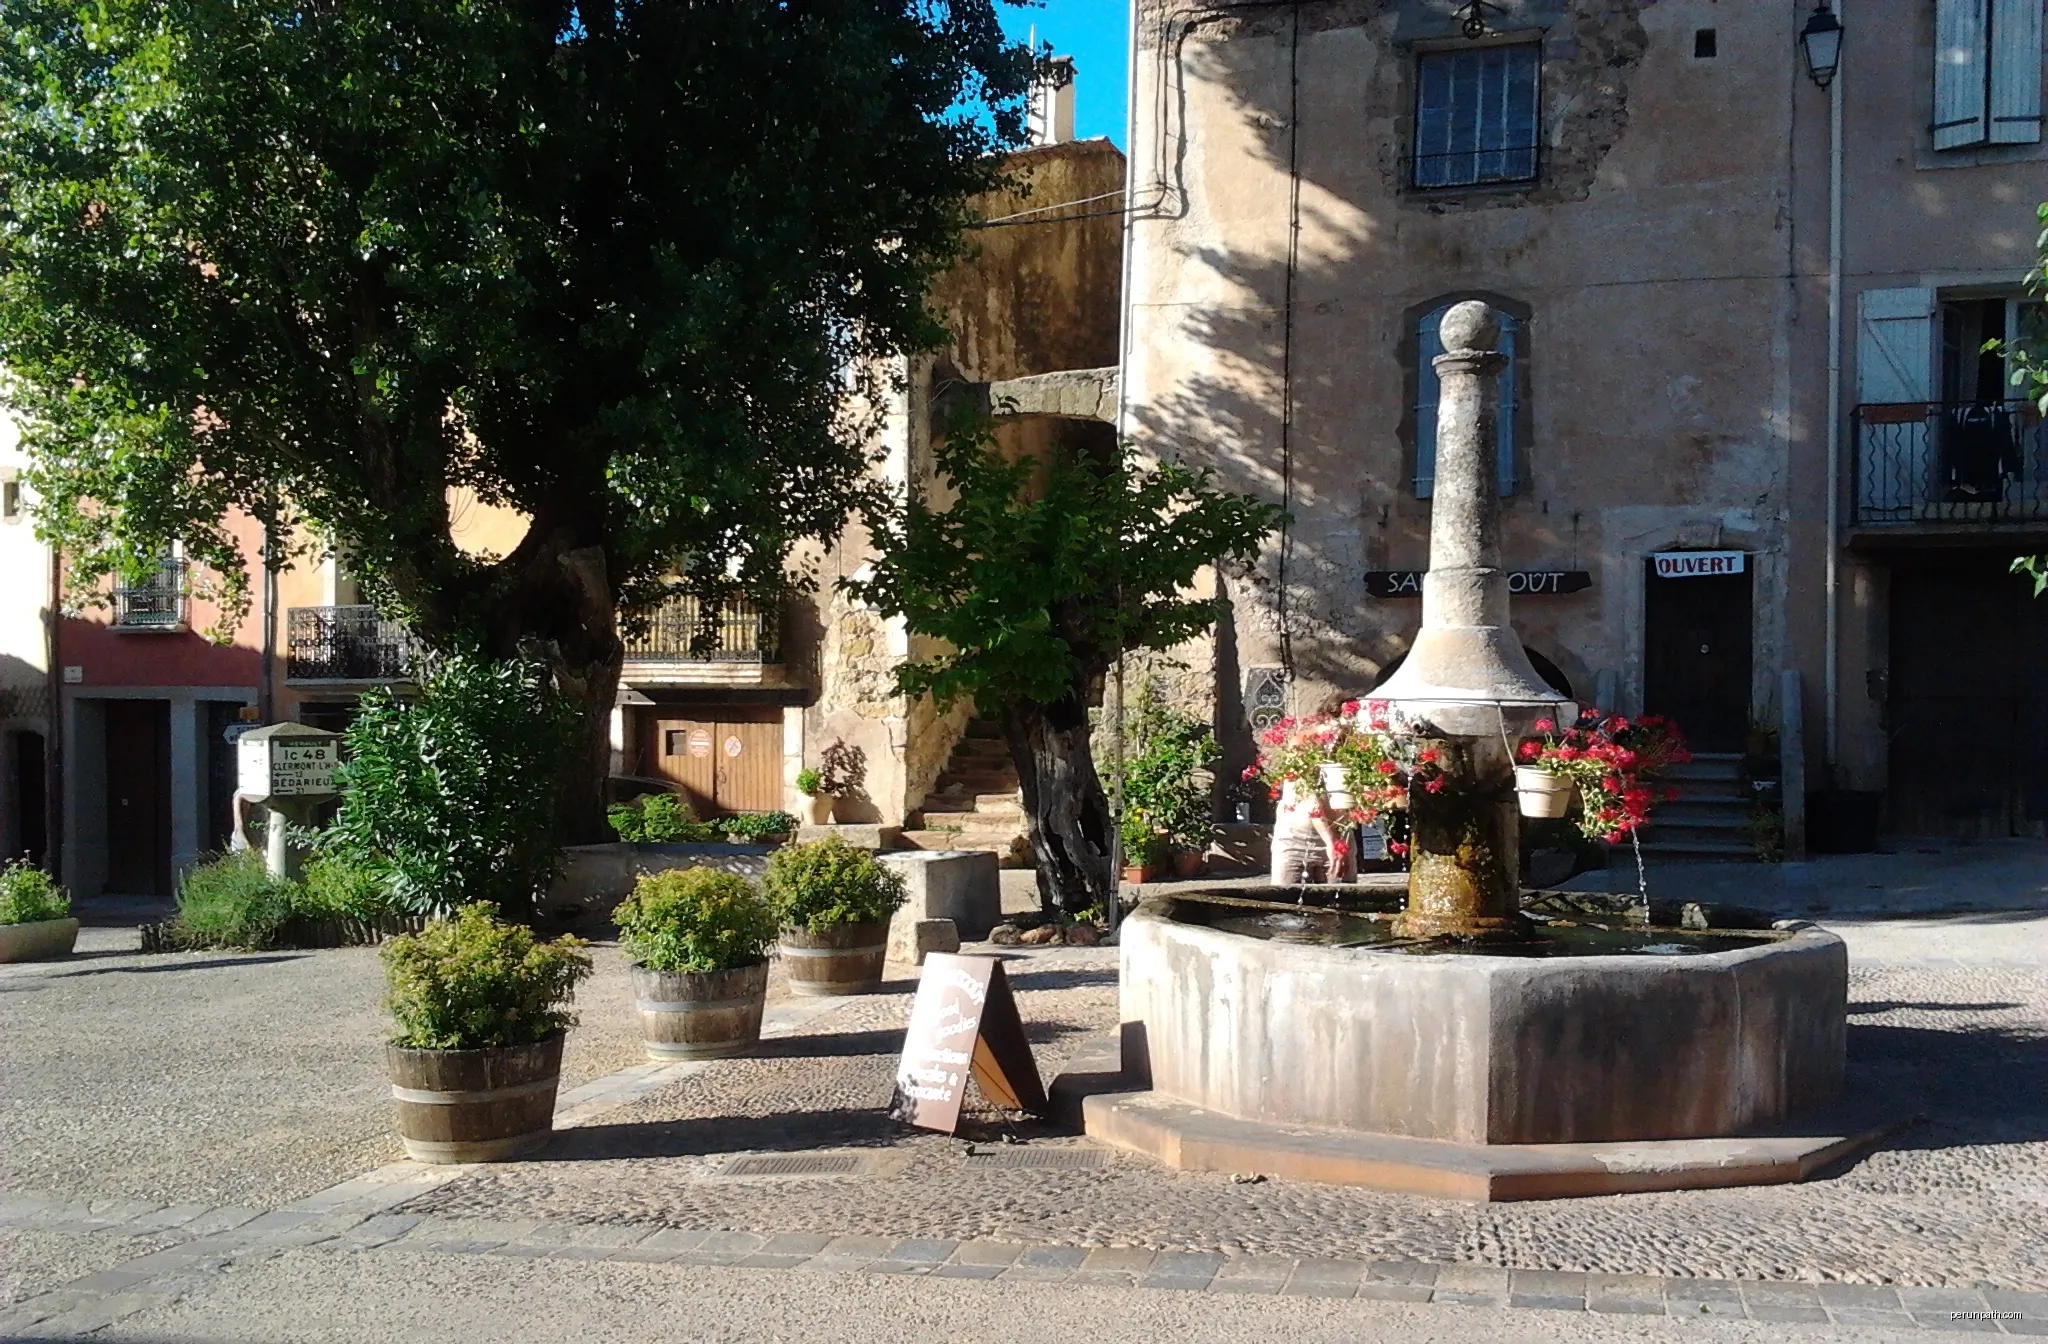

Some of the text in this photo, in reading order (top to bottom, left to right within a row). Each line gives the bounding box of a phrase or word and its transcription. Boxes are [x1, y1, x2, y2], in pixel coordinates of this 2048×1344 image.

[1658, 556, 1737, 574] OUVERT
[302, 749, 326, 760] 48
[273, 761, 316, 771] CLERMONT
